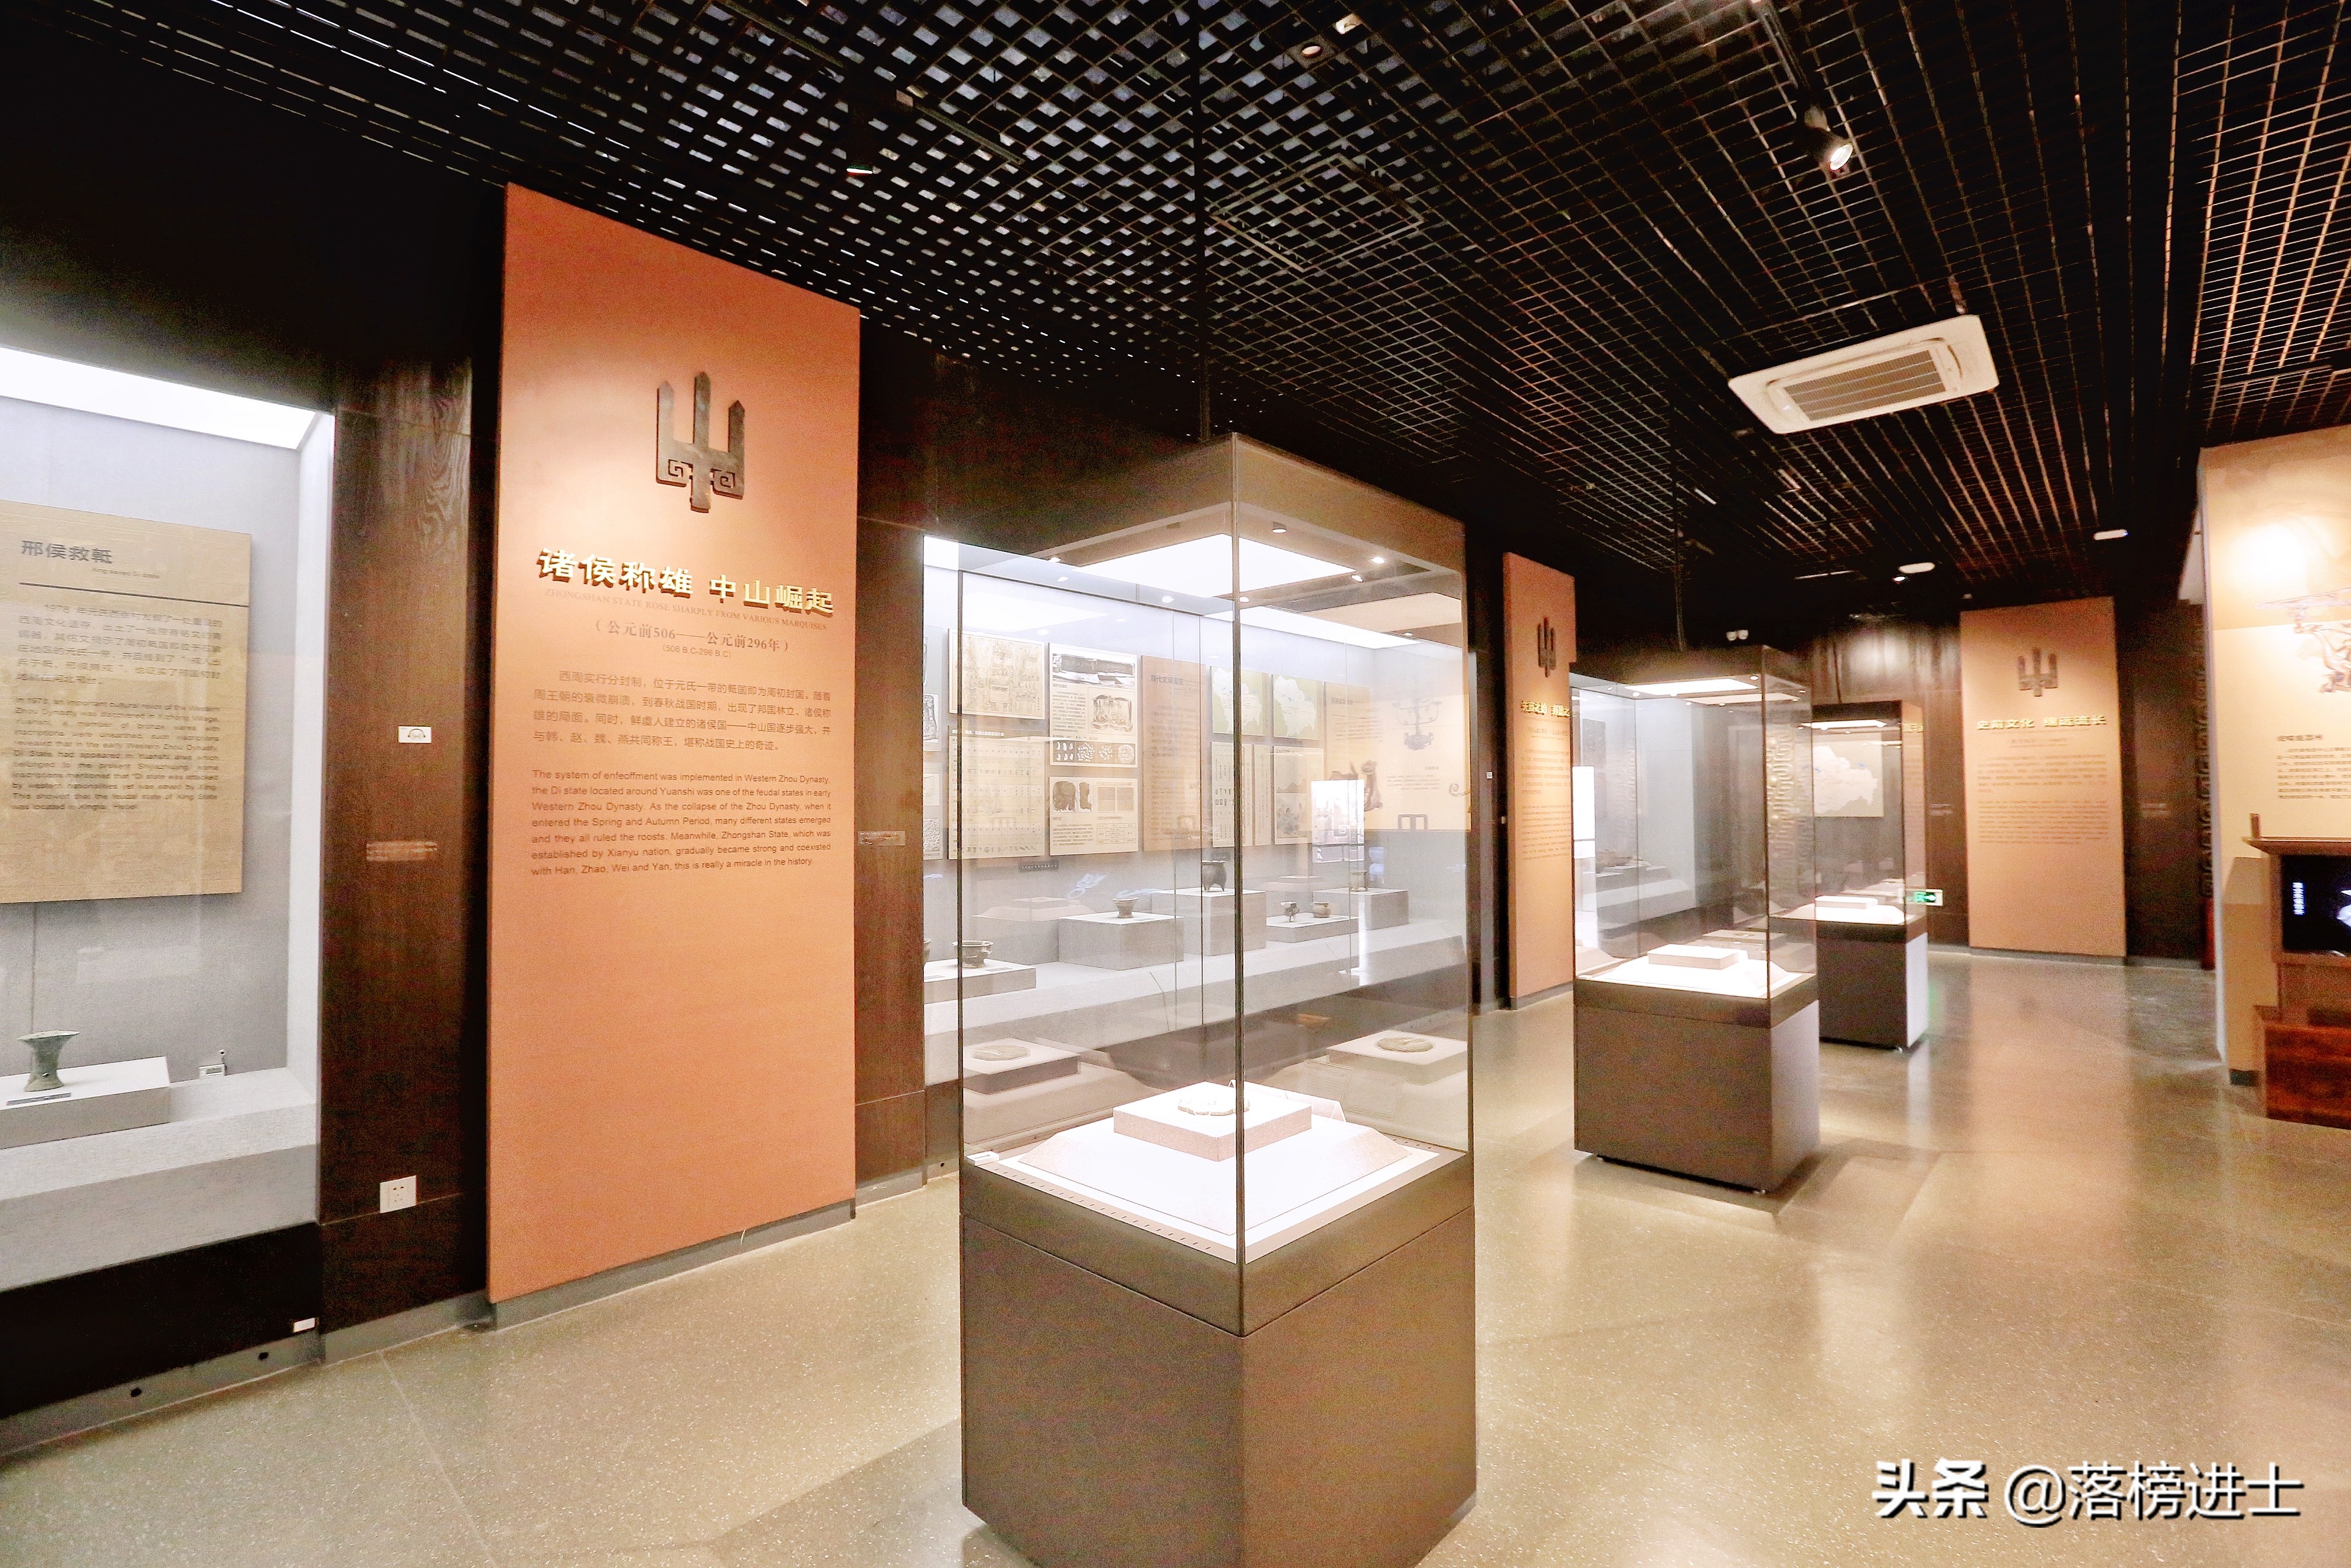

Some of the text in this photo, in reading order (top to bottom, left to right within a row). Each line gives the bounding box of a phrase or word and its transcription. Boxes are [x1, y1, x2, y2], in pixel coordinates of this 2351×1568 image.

[538, 547, 834, 617] 诸侯称雄 中山崛起
[612, 597, 642, 607] STATE
[645, 601, 670, 610] ROSE
[672, 604, 715, 616] SHARPLY
[715, 610, 740, 619] FROM
[742, 613, 779, 624] VARIOUS
[532, 769, 552, 778] The
[554, 770, 589, 781] system
[592, 771, 601, 779] of
[736, 774, 742, 782] in
[744, 774, 776, 782] Western
[778, 774, 797, 782] Zhou
[531, 785, 548, 794] the
[550, 786, 561, 794] Di
[564, 786, 587, 794] state
[589, 786, 624, 794] located
[626, 786, 657, 795] around
[659, 786, 694, 795] Yuanshi
[732, 788, 740, 796] of
[742, 788, 754, 796] the
[756, 788, 779, 796] feudal
[781, 788, 803, 796] states
[813, 788, 831, 798] early
[531, 802, 574, 810] Western
[578, 802, 602, 810] Zhou
[649, 802, 661, 810] As
[664, 802, 678, 810] the
[682, 802, 716, 812] collapse
[719, 802, 728, 810] of
[730, 802, 743, 810] the
[746, 802, 766, 810] Zhou
[804, 802, 824, 810] when
[826, 802, 831, 810] it
[531, 817, 569, 827] entered
[573, 817, 589, 826] the
[592, 817, 622, 828] Spring
[625, 817, 642, 825] and
[645, 817, 680, 825] Autumn
[715, 818, 738, 826] many
[740, 816, 771, 824] different
[774, 816, 796, 824] states
[799, 815, 831, 825] emerged
[531, 834, 551, 843] and
[554, 834, 575, 845] they
[578, 833, 590, 842] all
[593, 832, 617, 841] ruled
[620, 832, 634, 841] the
[721, 830, 765, 841] Zhongshan
[793, 829, 814, 837] which
[592, 848, 603, 859] by
[607, 847, 638, 858] Xianyu
[675, 845, 714, 856] gradually
[717, 844, 749, 853] became
[753, 844, 776, 854] strong
[779, 843, 793, 851] and
[797, 842, 831, 850] coexisted
[531, 865, 551, 874] with
[611, 863, 629, 872] Wei
[632, 862, 649, 871] and
[674, 860, 689, 869] this
[692, 860, 699, 869] is
[702, 859, 724, 870] really
[733, 858, 762, 867] miracle
[765, 858, 771, 866] in
[774, 857, 785, 865] the
